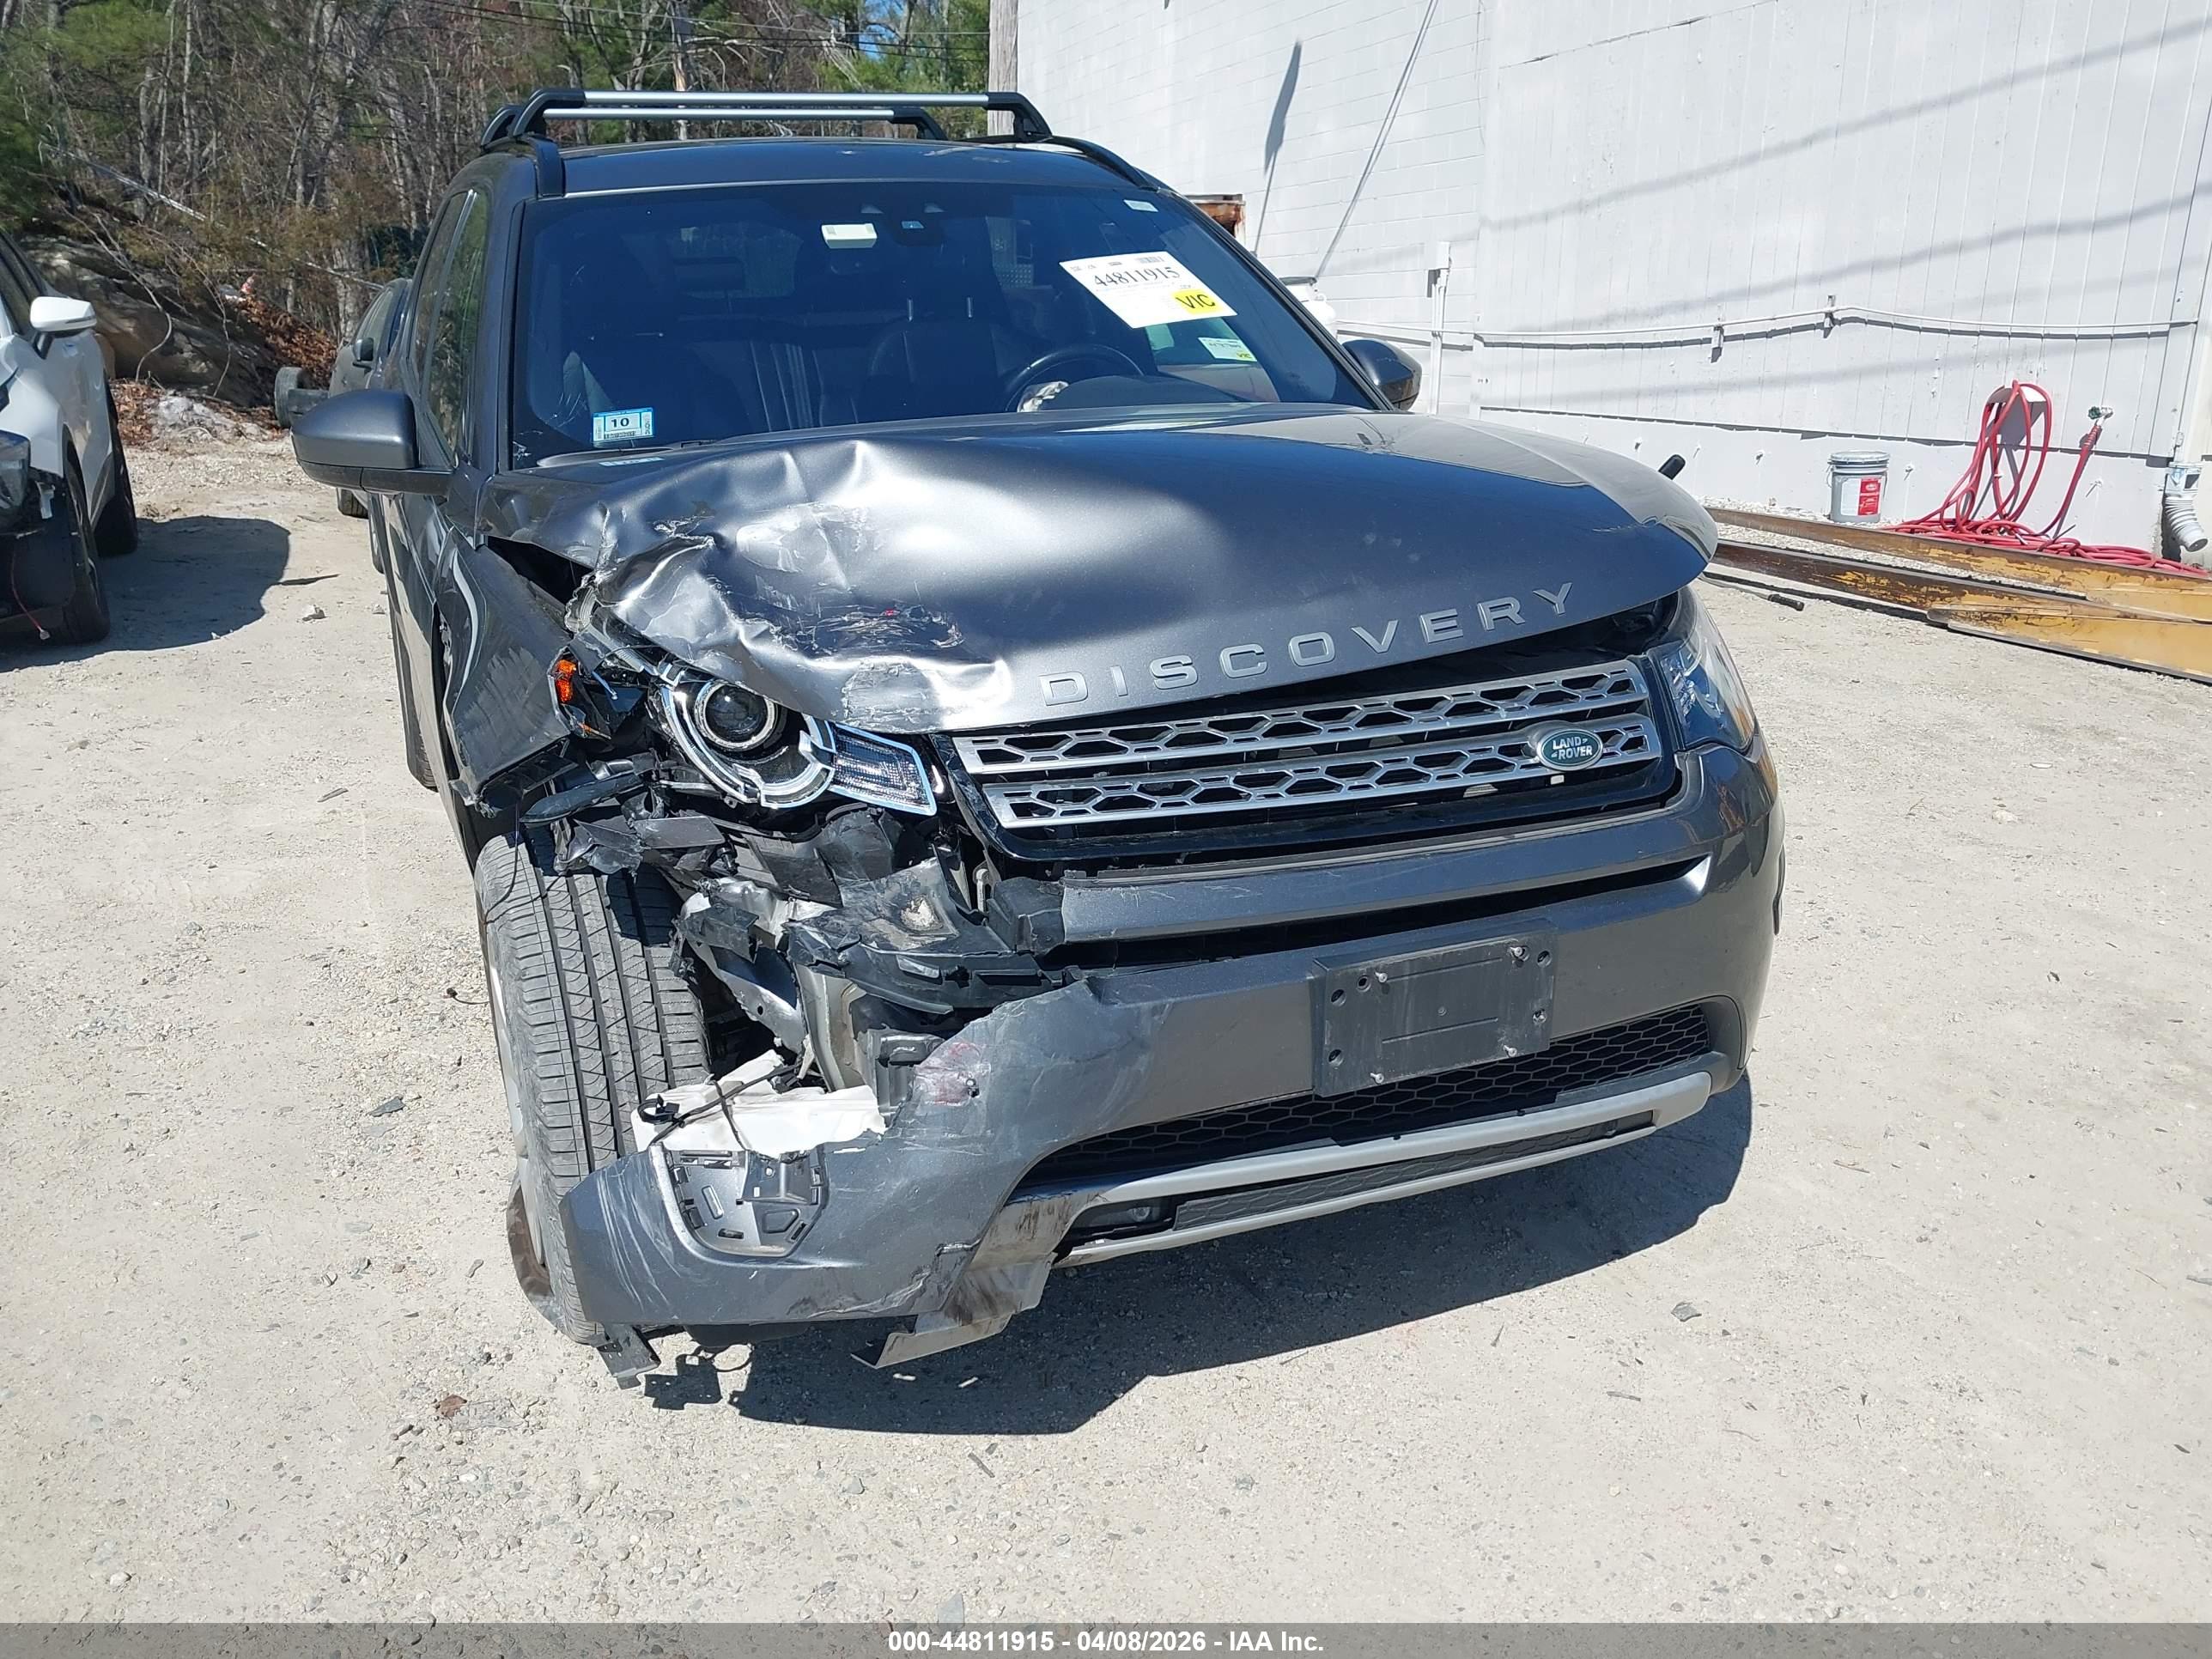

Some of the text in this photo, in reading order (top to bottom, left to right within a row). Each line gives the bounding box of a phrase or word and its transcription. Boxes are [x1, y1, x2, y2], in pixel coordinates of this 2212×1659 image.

[1094, 266, 1181, 287] 44811915
[1176, 294, 1216, 309] VIC
[611, 417, 629, 428] 10
[1037, 582, 1572, 707] DISCOVERY
[1553, 736, 1582, 750] LAND
[1558, 744, 1593, 760] ROVER
